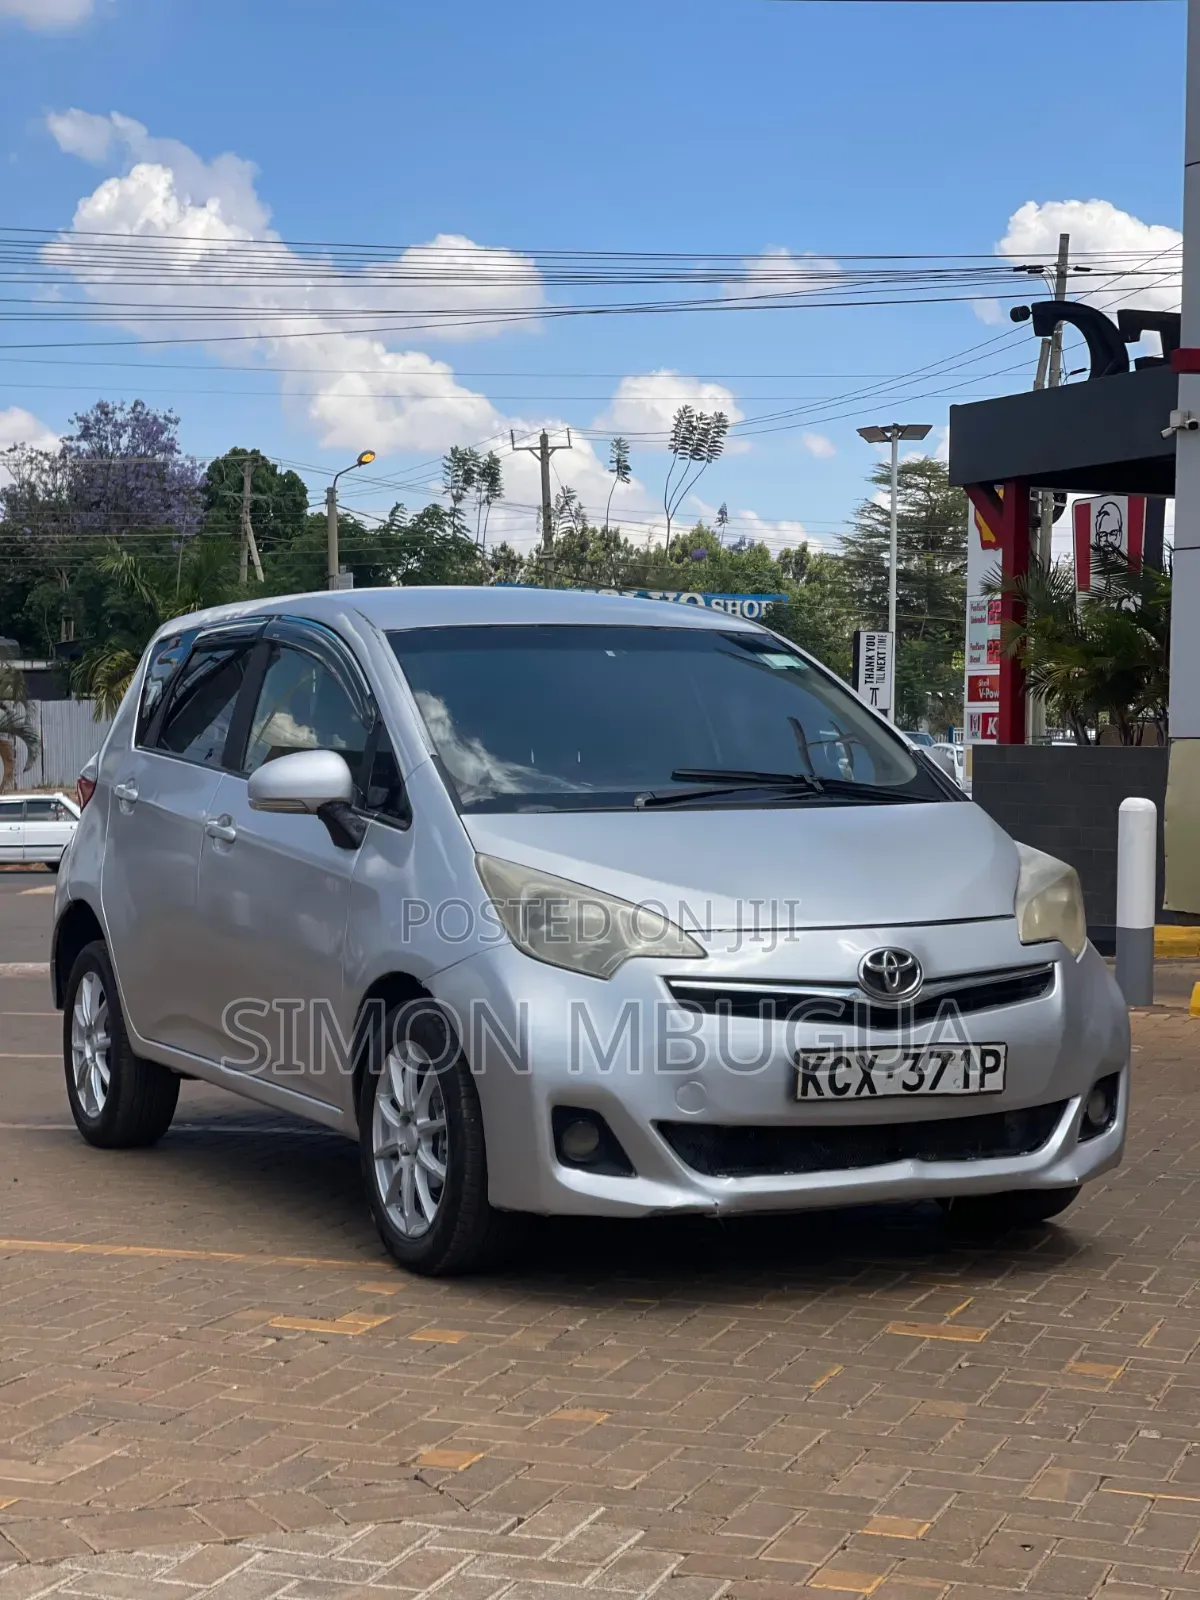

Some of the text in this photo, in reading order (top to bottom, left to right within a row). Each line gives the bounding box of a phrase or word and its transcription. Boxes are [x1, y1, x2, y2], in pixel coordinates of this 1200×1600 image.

[864, 635, 876, 684] THANK YOU
[876, 634, 887, 684] TILL NEXT TIME
[970, 655, 980, 663] Diesel
[979, 679, 989, 687] Shell
[800, 1048, 1001, 1097] KCX 371P
